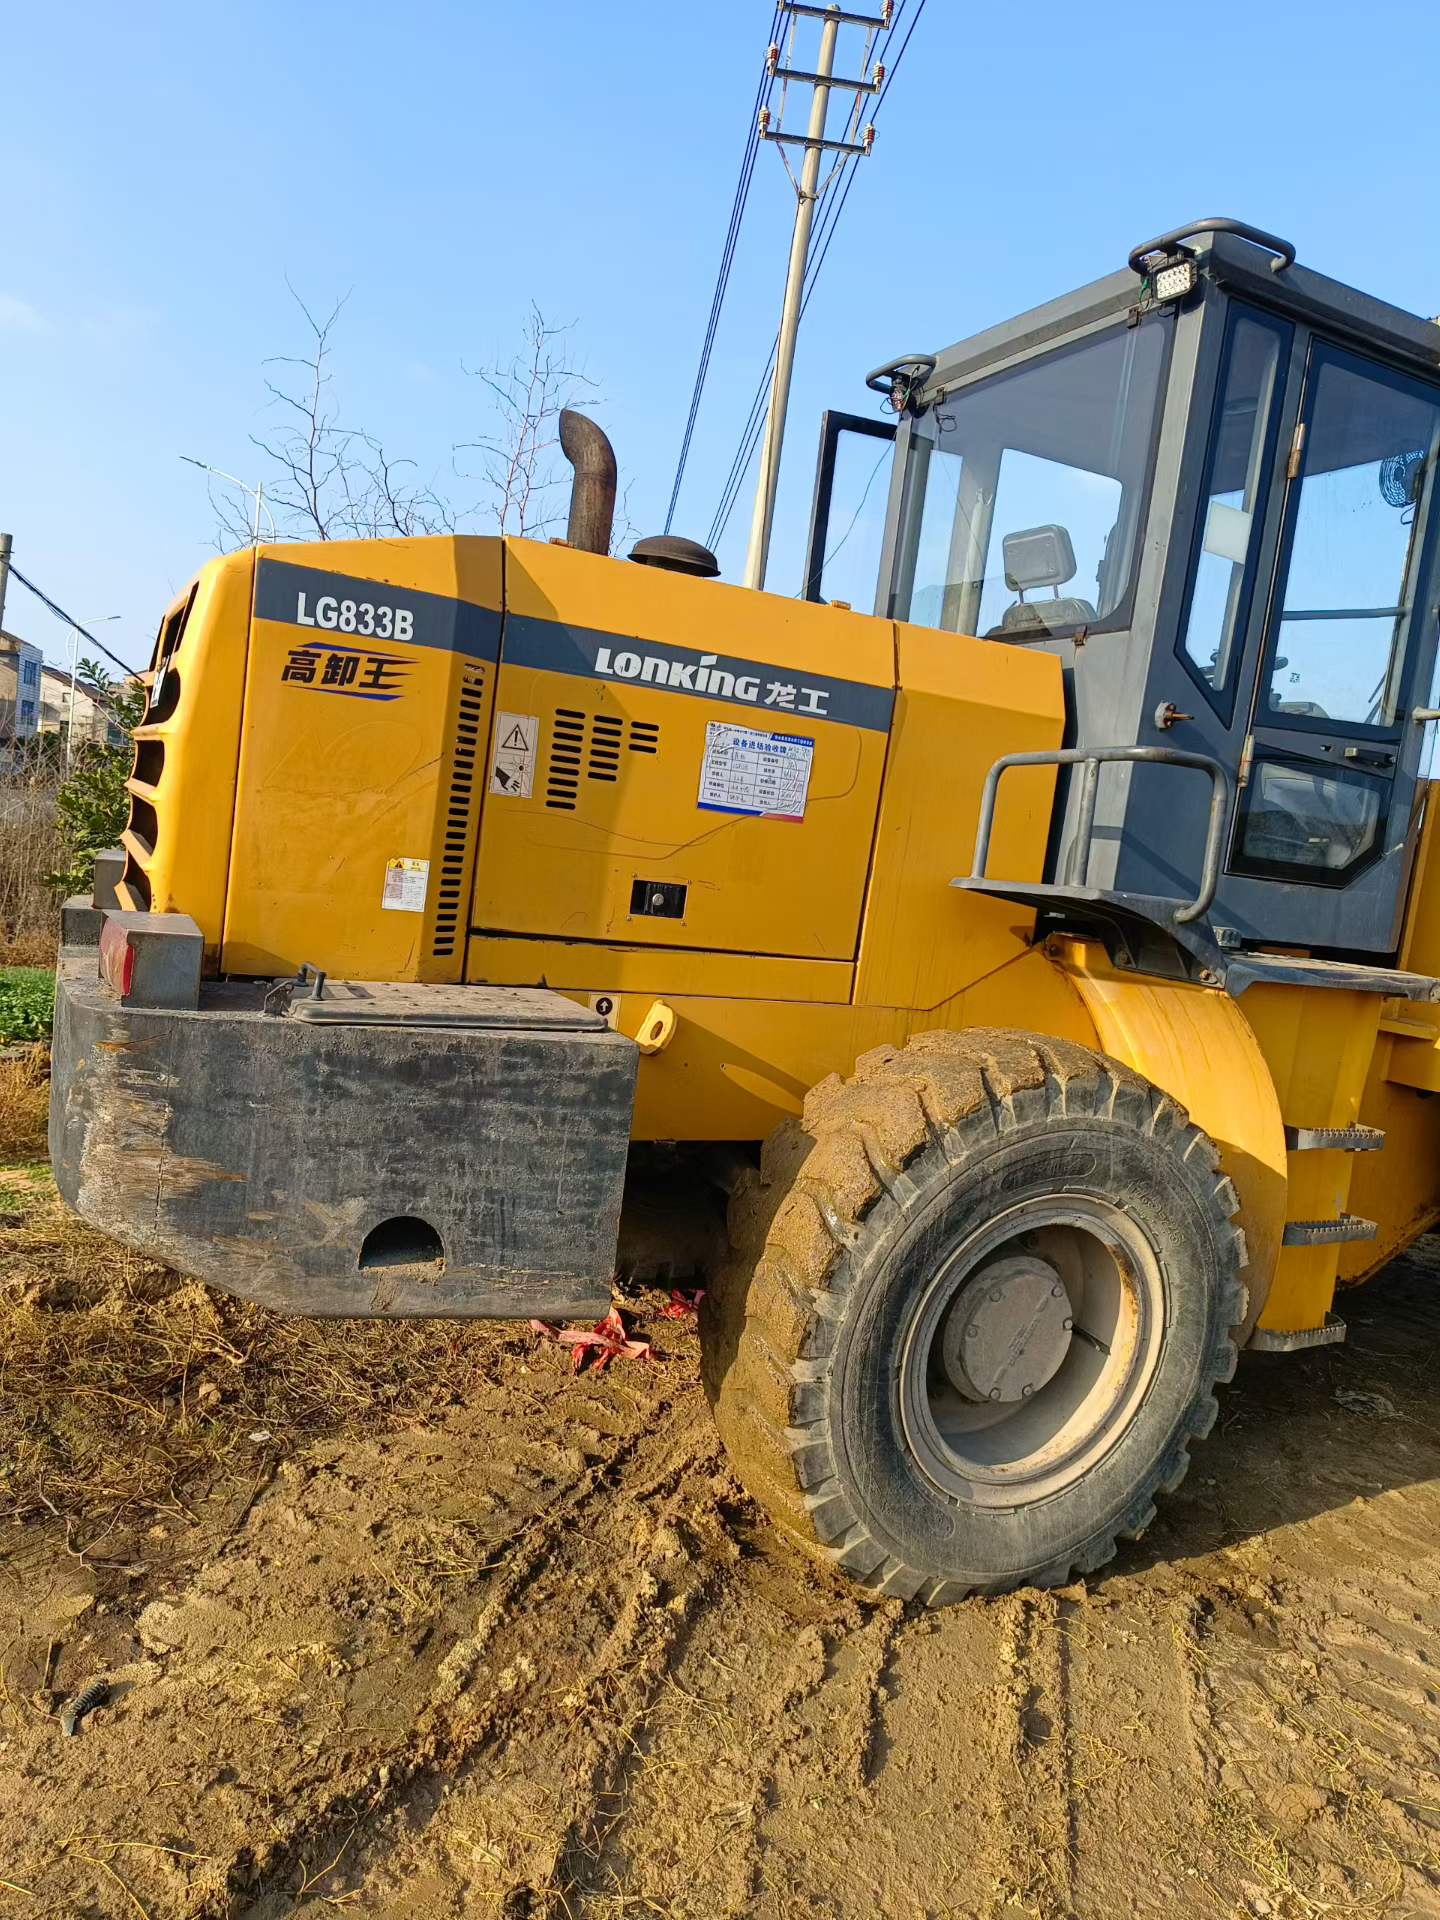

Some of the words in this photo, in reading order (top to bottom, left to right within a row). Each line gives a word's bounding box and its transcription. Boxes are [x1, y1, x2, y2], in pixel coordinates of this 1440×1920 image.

[296, 592, 414, 641] LG833B
[281, 649, 419, 690] 高卸王
[763, 682, 830, 716] 龙工
